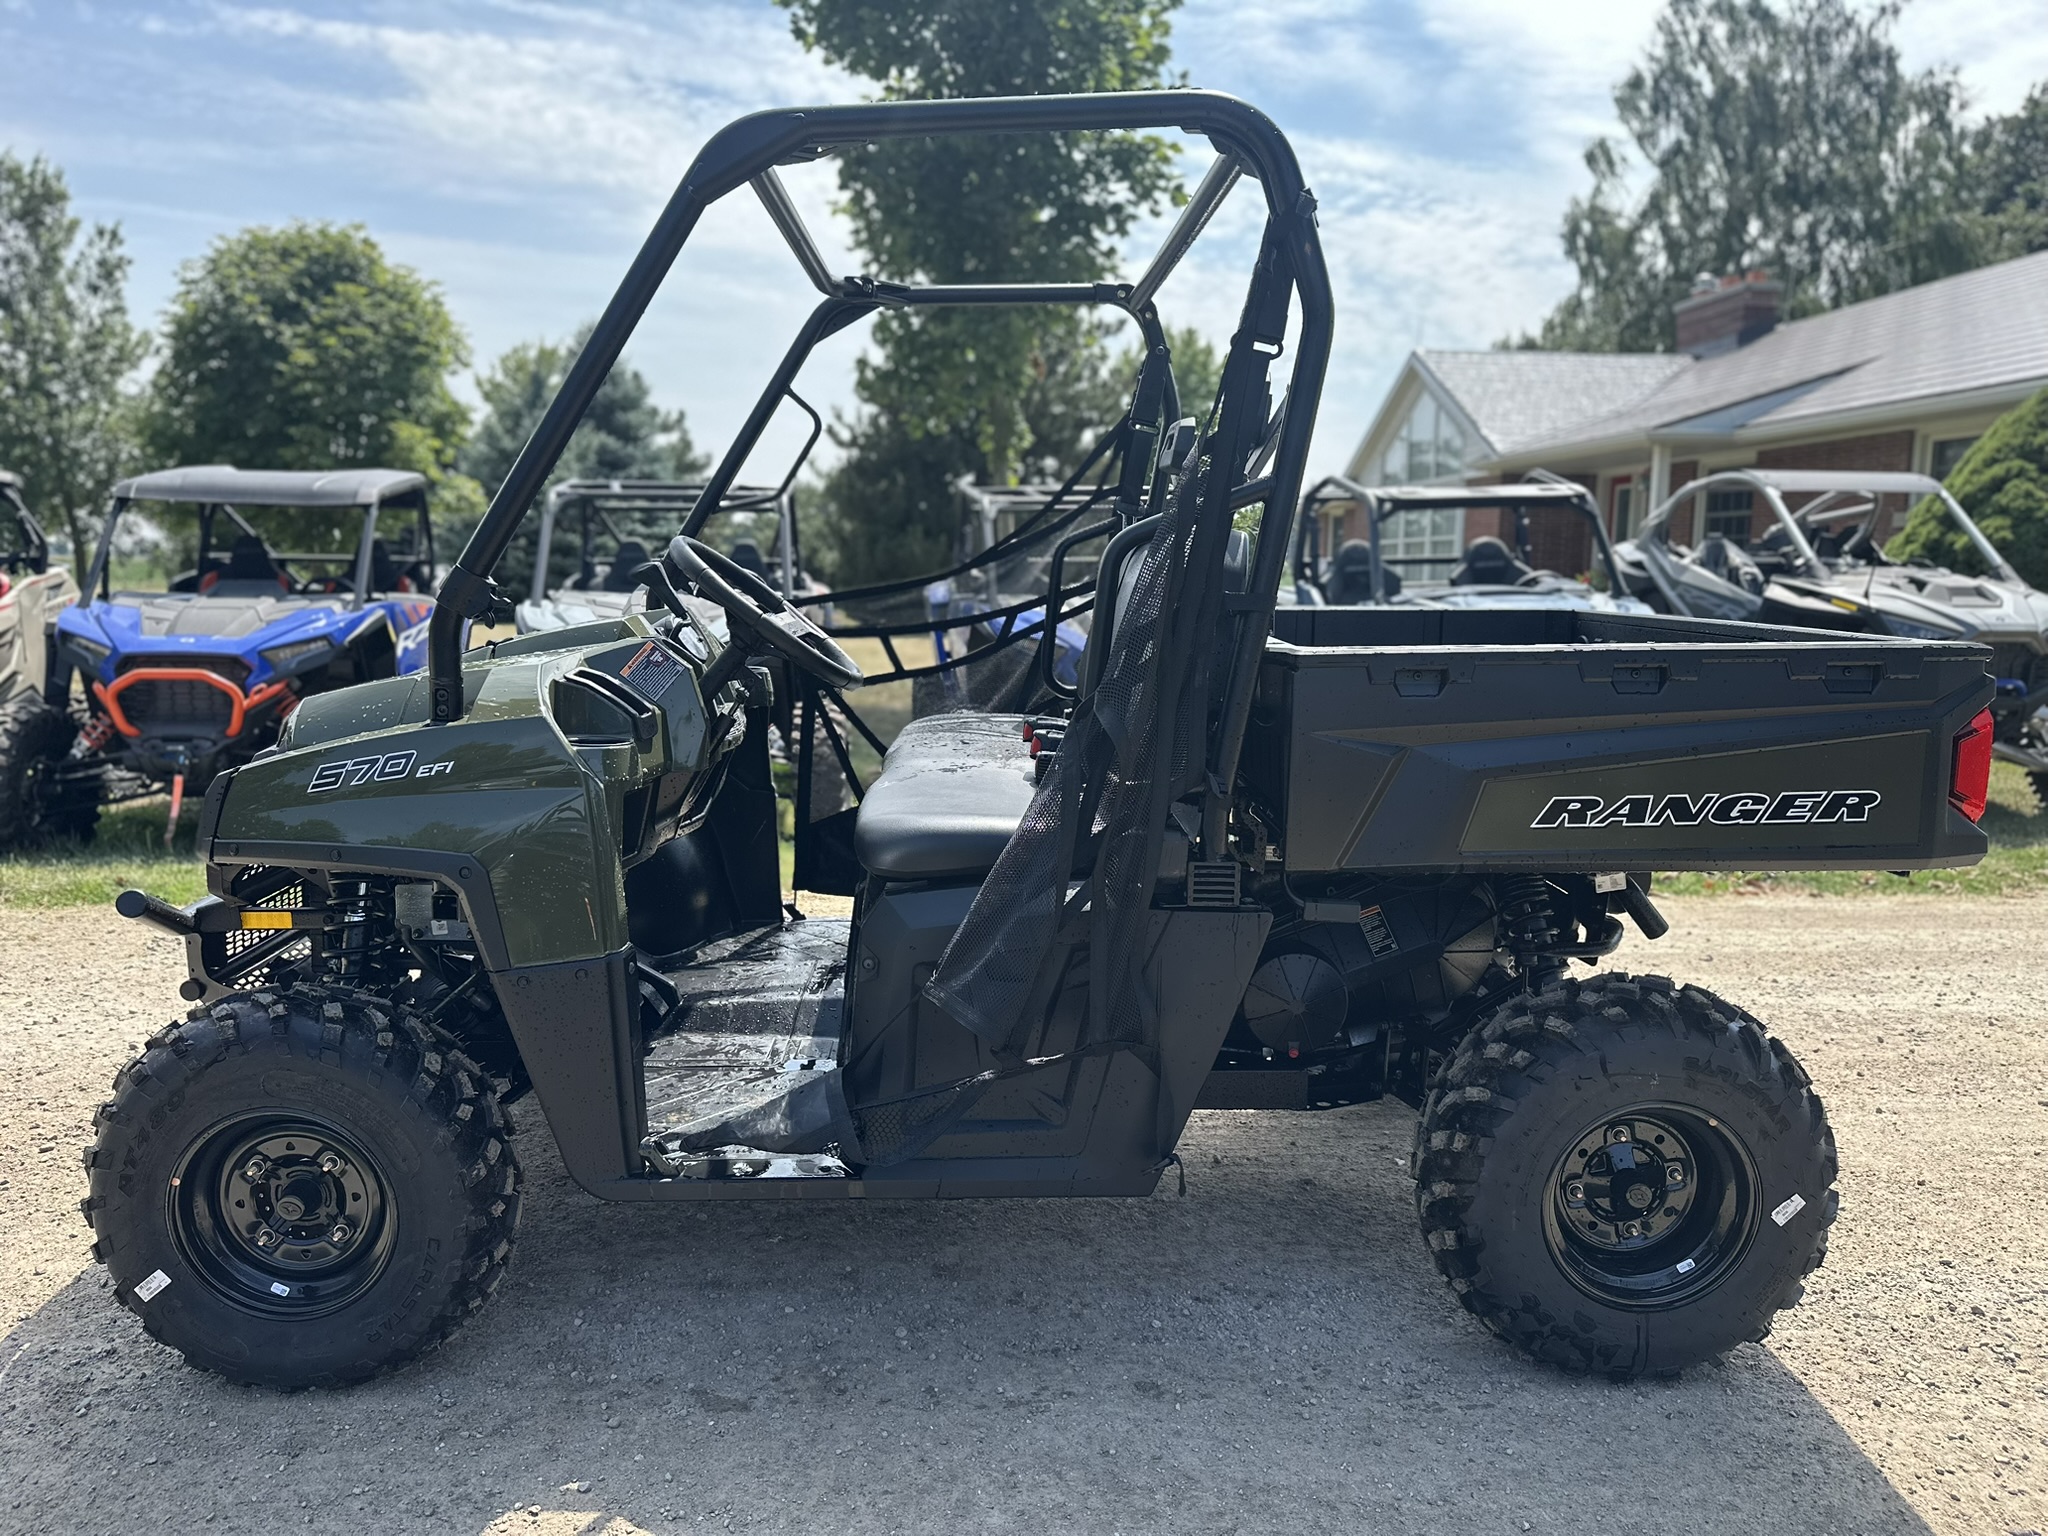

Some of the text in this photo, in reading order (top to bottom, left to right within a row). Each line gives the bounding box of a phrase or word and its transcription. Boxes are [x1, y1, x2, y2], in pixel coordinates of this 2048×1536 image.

[396, 618, 430, 658] RZ
[307, 750, 455, 793] 570 EFI
[1530, 790, 1881, 828] RANGER
[366, 1238, 440, 1343] CARLSTAR
